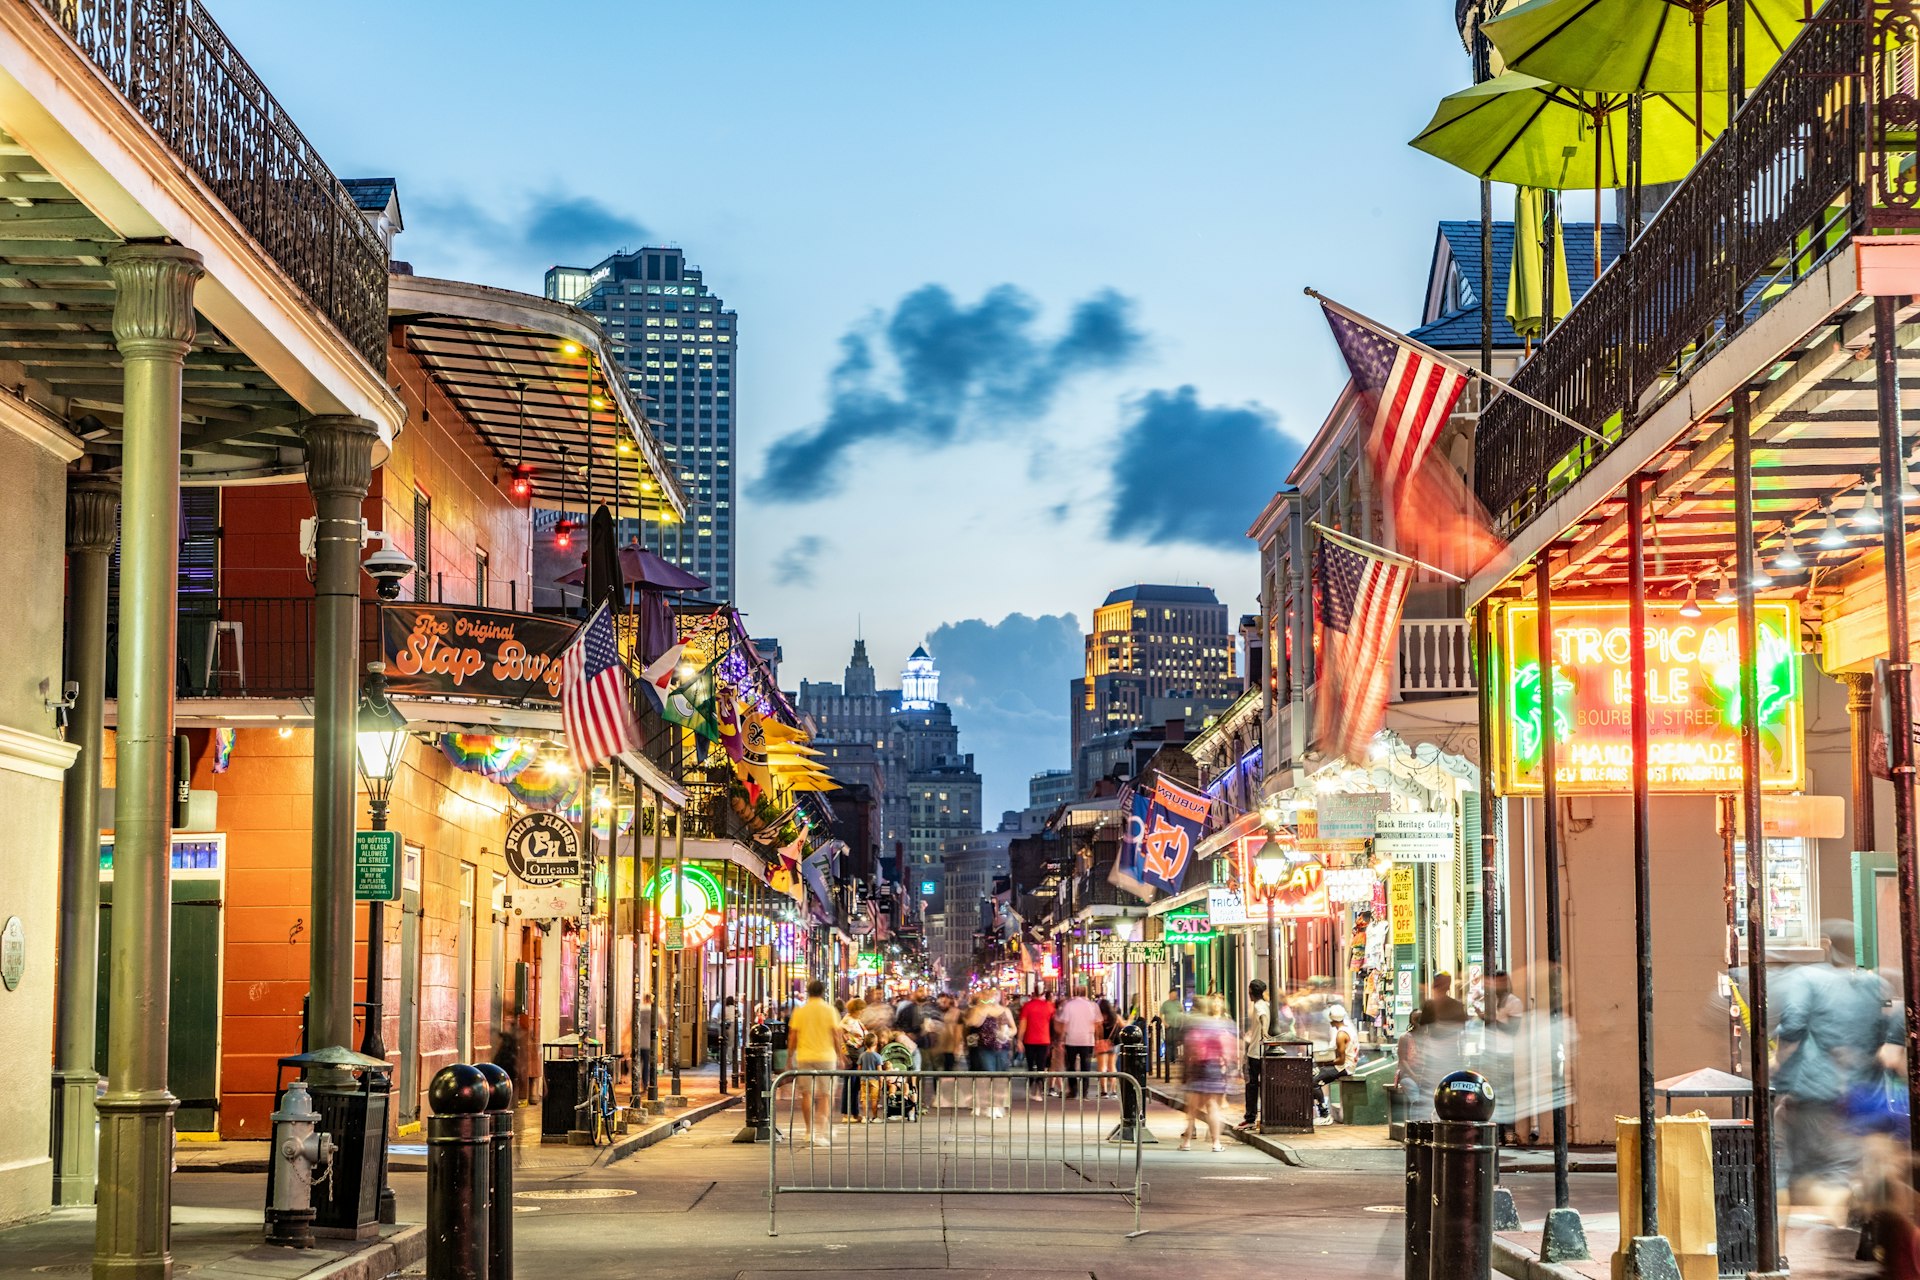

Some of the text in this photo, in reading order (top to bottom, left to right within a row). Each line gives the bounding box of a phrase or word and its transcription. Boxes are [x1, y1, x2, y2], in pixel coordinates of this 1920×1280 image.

[413, 614, 515, 644] The Original
[1555, 625, 1742, 665] TROPICAL
[396, 634, 563, 698] Slap Burg
[1613, 667, 1689, 705] ISLE
[1577, 707, 1725, 726] BOURBN STREET
[1645, 743, 1736, 765] RENADE
[1644, 766, 1667, 782] OST
[1672, 766, 1727, 782] POWERFUL
[506, 815, 576, 853] POUR HOUSE
[1299, 822, 1318, 839] BOU
[1377, 820, 1395, 829] Black
[1398, 820, 1425, 831] Heritage
[1427, 820, 1450, 831] Gallery
[530, 864, 575, 875] Orleans
[699, 877, 718, 906] GRANDE
[1329, 885, 1369, 902] SHOP
[1392, 883, 1412, 892] JAZZ FEST
[1396, 892, 1409, 901] SALE
[1393, 904, 1413, 918] 50%
[1396, 919, 1411, 931] OFF
[1099, 948, 1166, 963] PRESERATION-JAZZ
